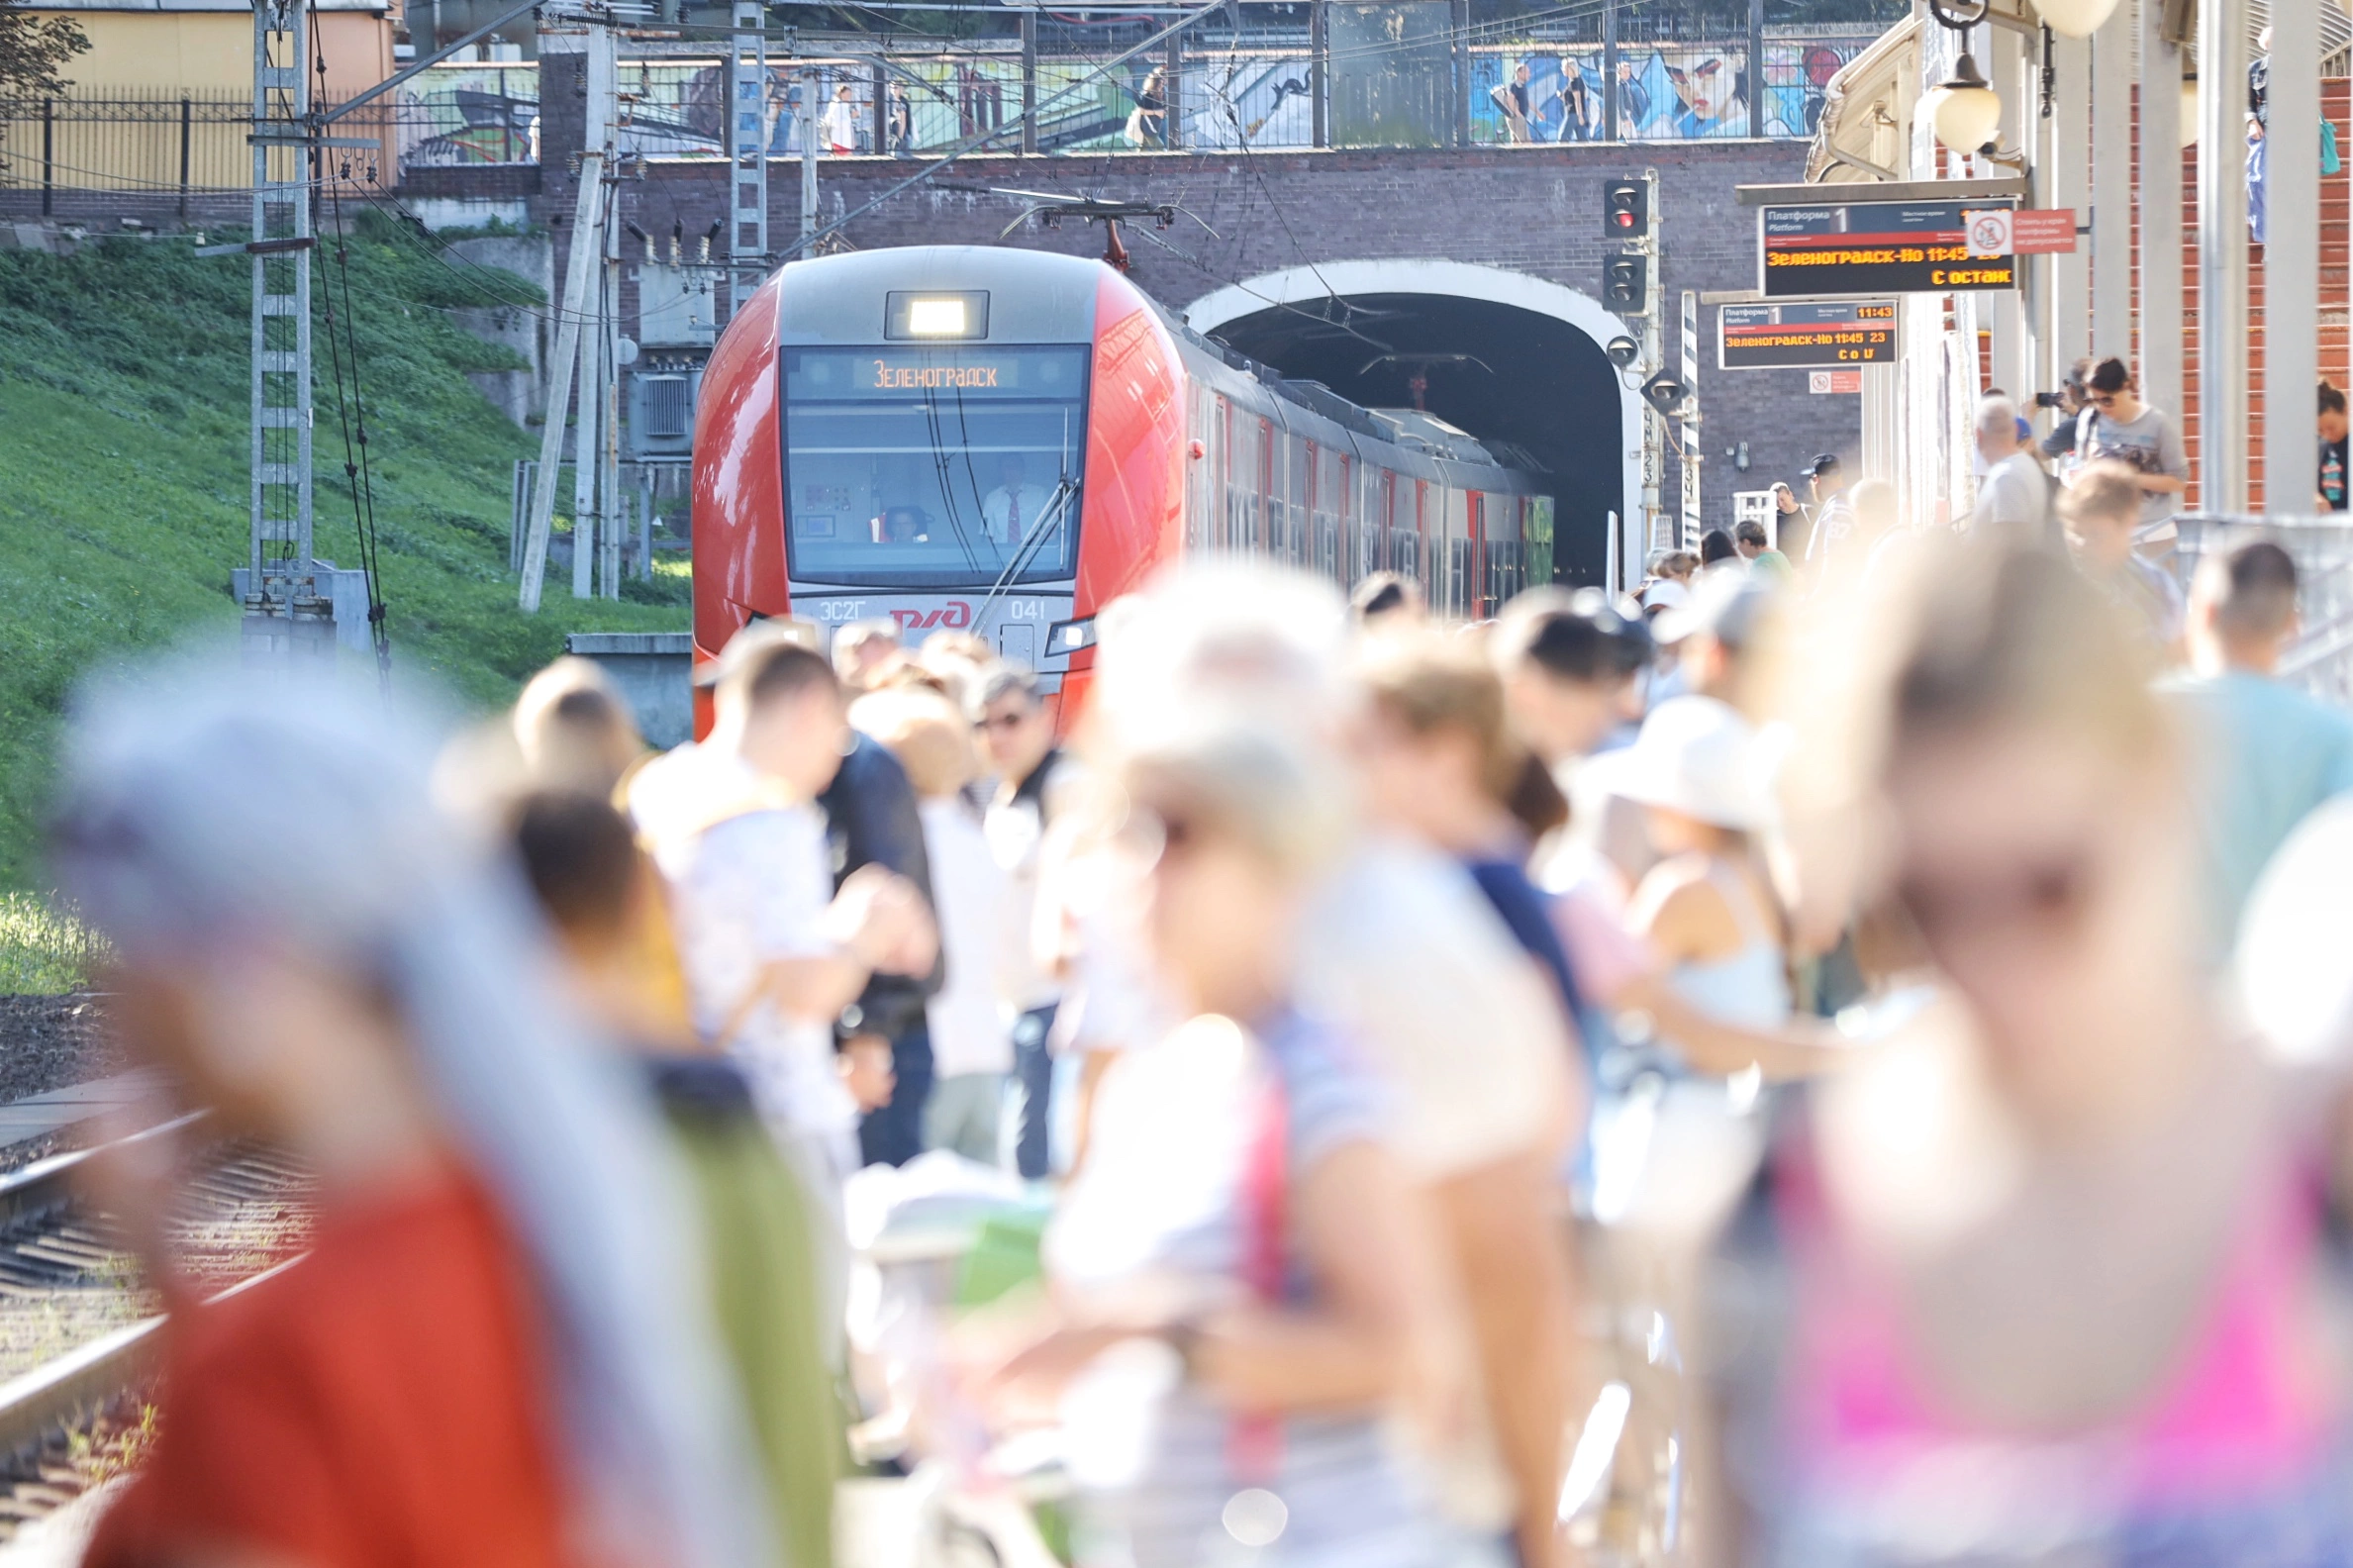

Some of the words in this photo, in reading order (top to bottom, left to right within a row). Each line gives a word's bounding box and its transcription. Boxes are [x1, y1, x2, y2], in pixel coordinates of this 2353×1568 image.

[1768, 211, 1830, 222] Платформа
[1835, 208, 1847, 233] 1
[1769, 223, 1804, 232] Platform
[1771, 307, 1779, 325] 1
[1858, 307, 1893, 318] 11:43
[1835, 333, 1864, 343] 11:45
[1869, 333, 1886, 343] 23
[1011, 601, 1045, 620] 041
